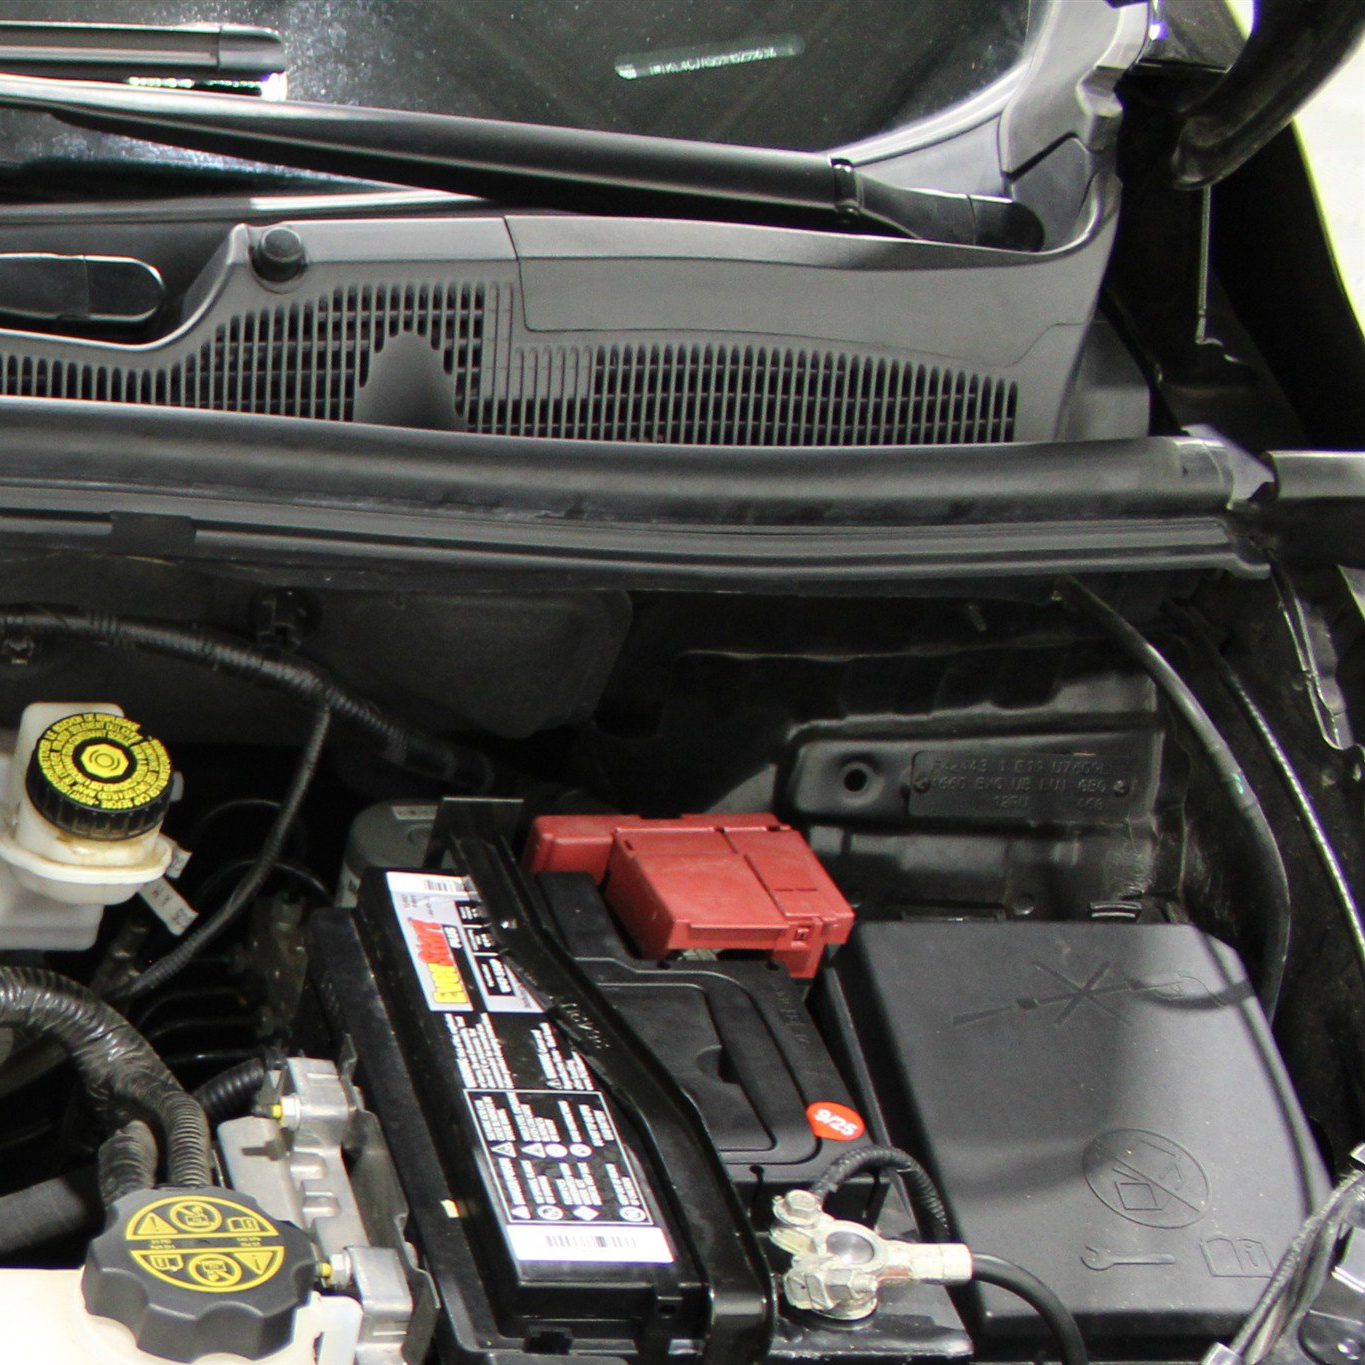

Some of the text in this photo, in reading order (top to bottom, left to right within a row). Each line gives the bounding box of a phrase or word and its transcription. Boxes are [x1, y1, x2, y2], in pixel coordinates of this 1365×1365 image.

[443, 926, 464, 949] PLUS
[408, 918, 470, 1005] EverStart
[813, 1108, 859, 1137] 9/25
